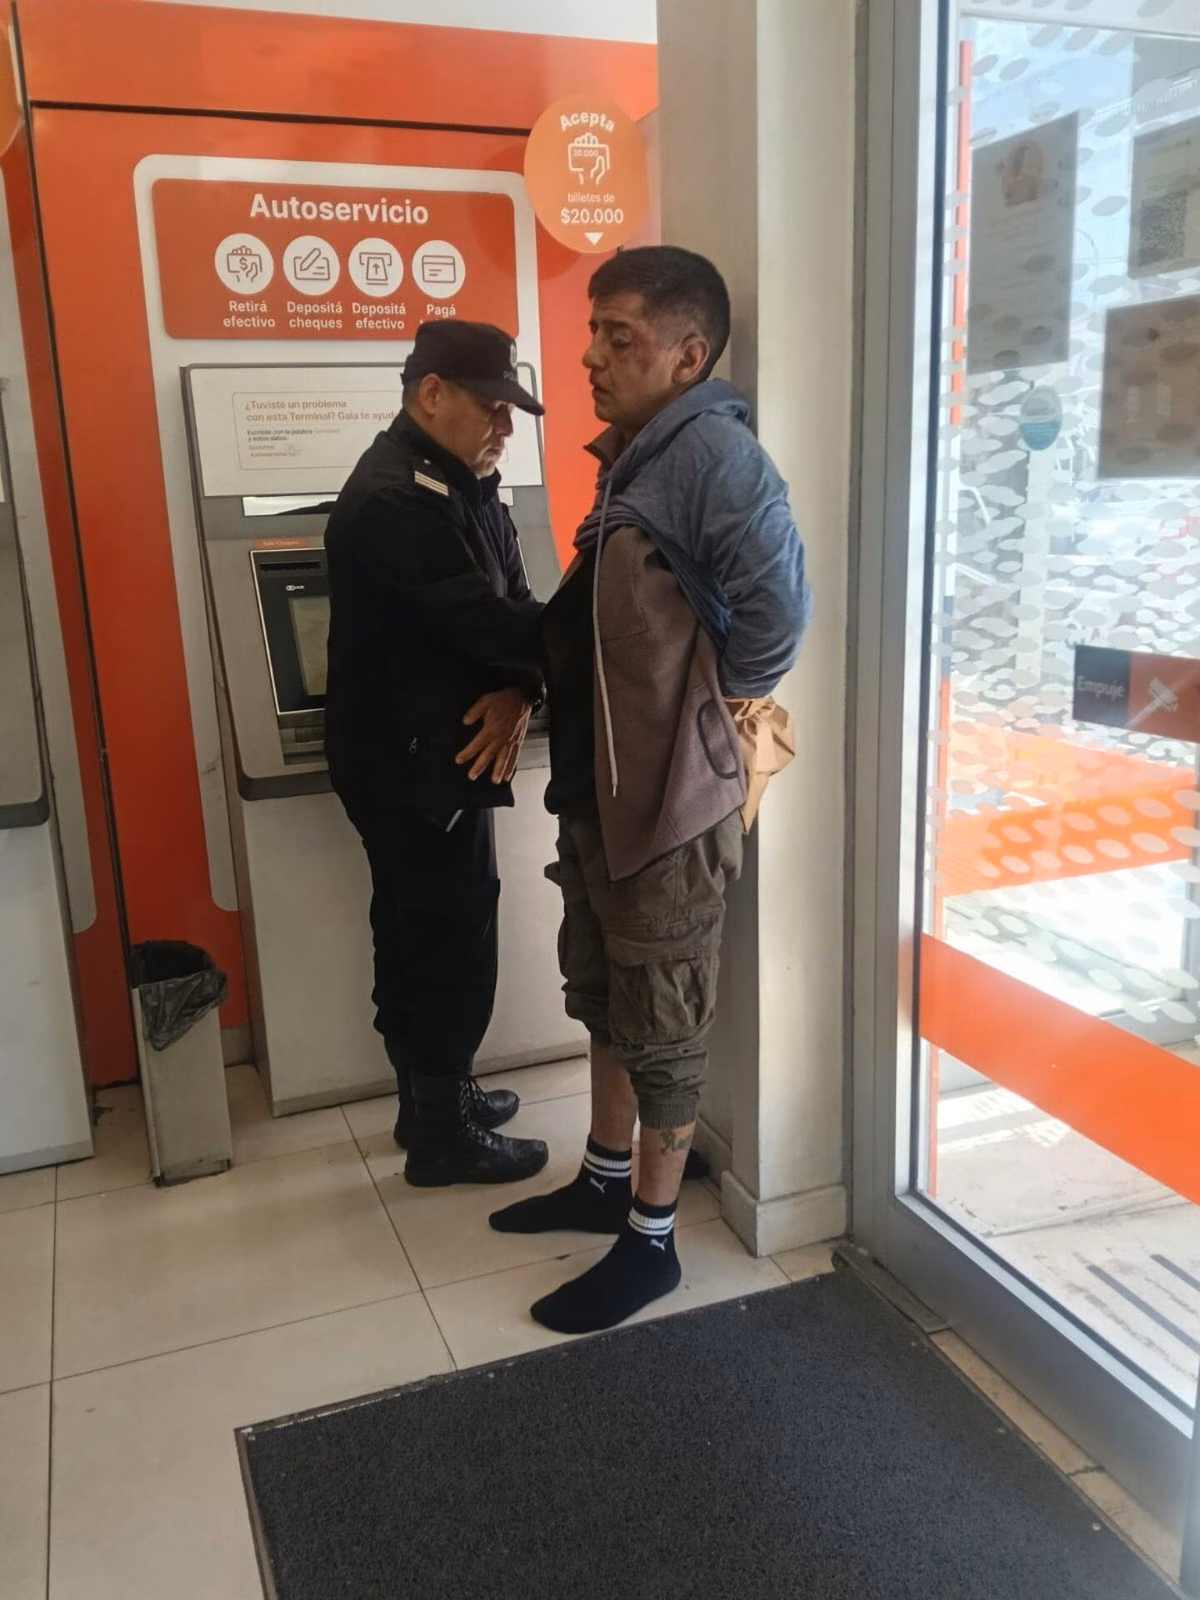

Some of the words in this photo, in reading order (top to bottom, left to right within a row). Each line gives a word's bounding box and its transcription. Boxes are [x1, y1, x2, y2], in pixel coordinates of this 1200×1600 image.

[560, 112, 615, 132] Acepta
[567, 192, 601, 203] billetes
[603, 192, 615, 202] de
[249, 193, 429, 225] Autoservicio
[560, 208, 624, 225] $20.000
[228, 300, 267, 314] Retirá
[287, 301, 343, 316] Depositá
[352, 302, 406, 317] Depositá
[426, 303, 456, 318] Pagá
[223, 316, 276, 329] efectivo
[289, 317, 343, 330] cheques
[355, 318, 405, 330] efectivo
[245, 400, 286, 411] ¿Tuviste
[288, 401, 300, 409] un
[302, 399, 347, 411] problema
[246, 414, 264, 422] con
[266, 413, 288, 421] esta
[289, 411, 336, 421] Terminal?
[360, 412, 370, 420] te
[1077, 675, 1125, 701] Empuje
